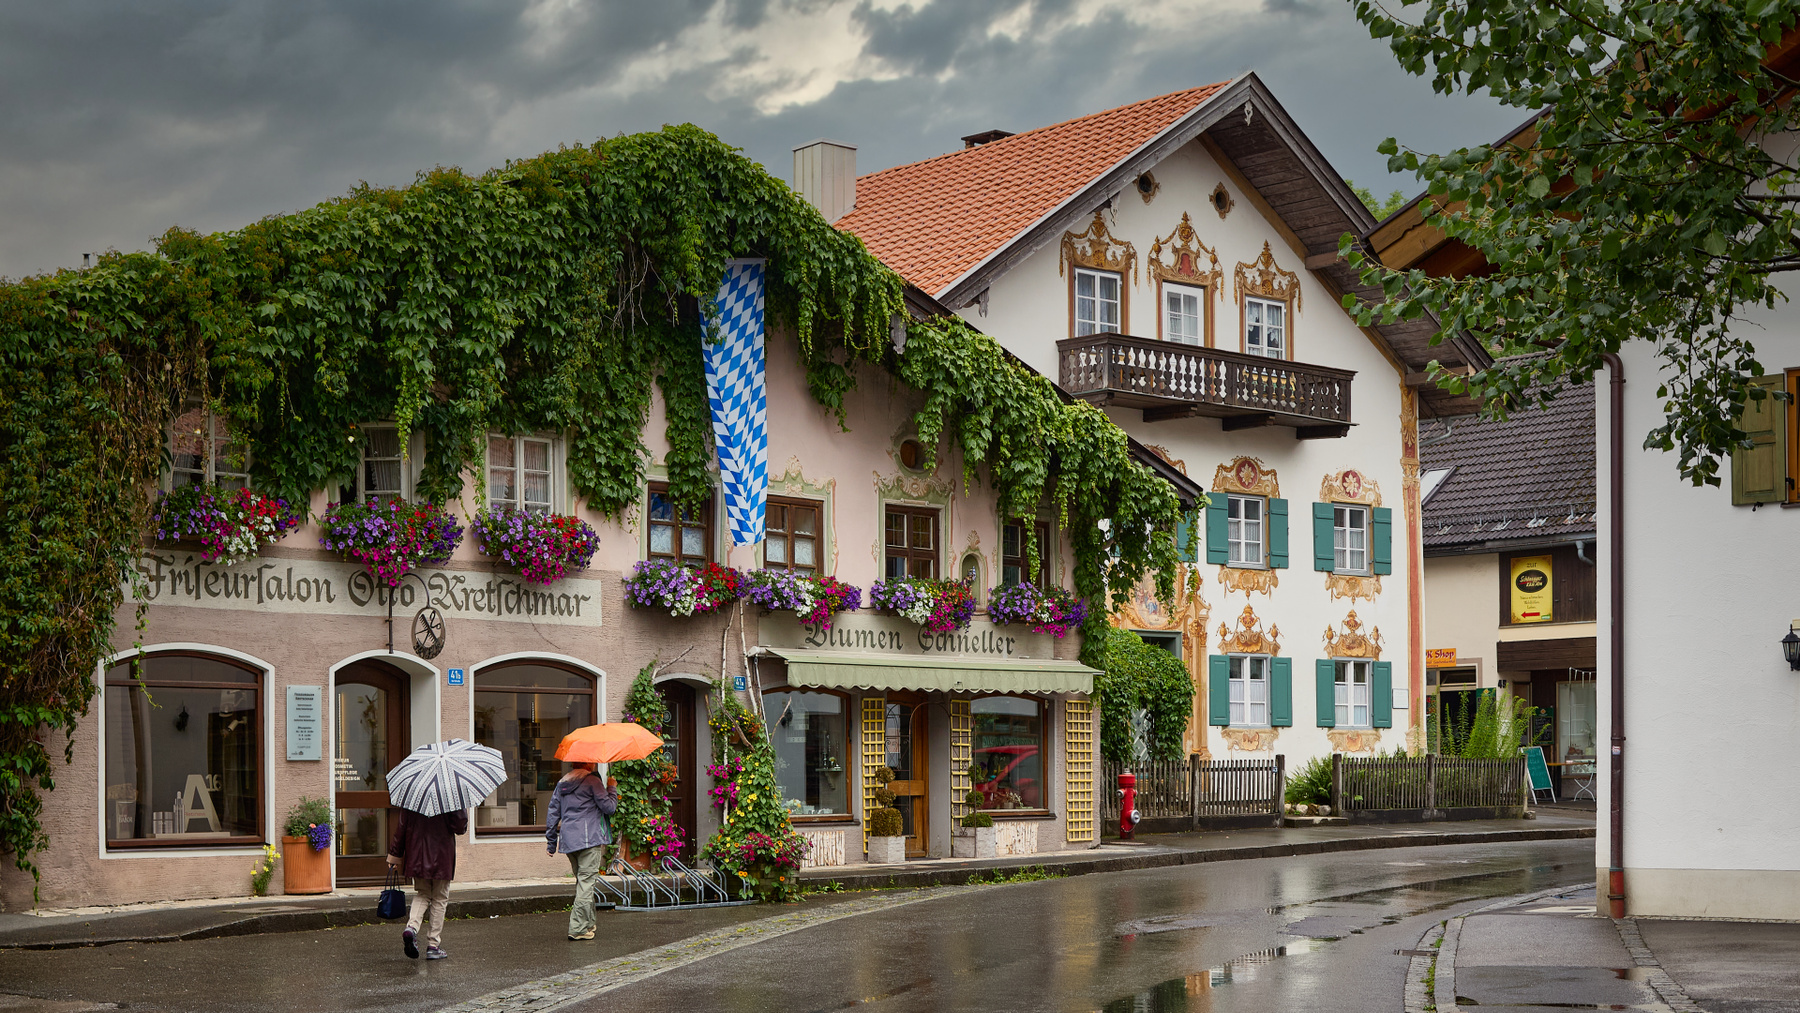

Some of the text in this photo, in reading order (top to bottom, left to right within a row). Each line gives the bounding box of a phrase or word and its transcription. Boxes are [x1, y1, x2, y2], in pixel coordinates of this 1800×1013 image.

[805, 619, 1015, 655] Blumen Schneller
[1435, 649, 1455, 660] Shop
